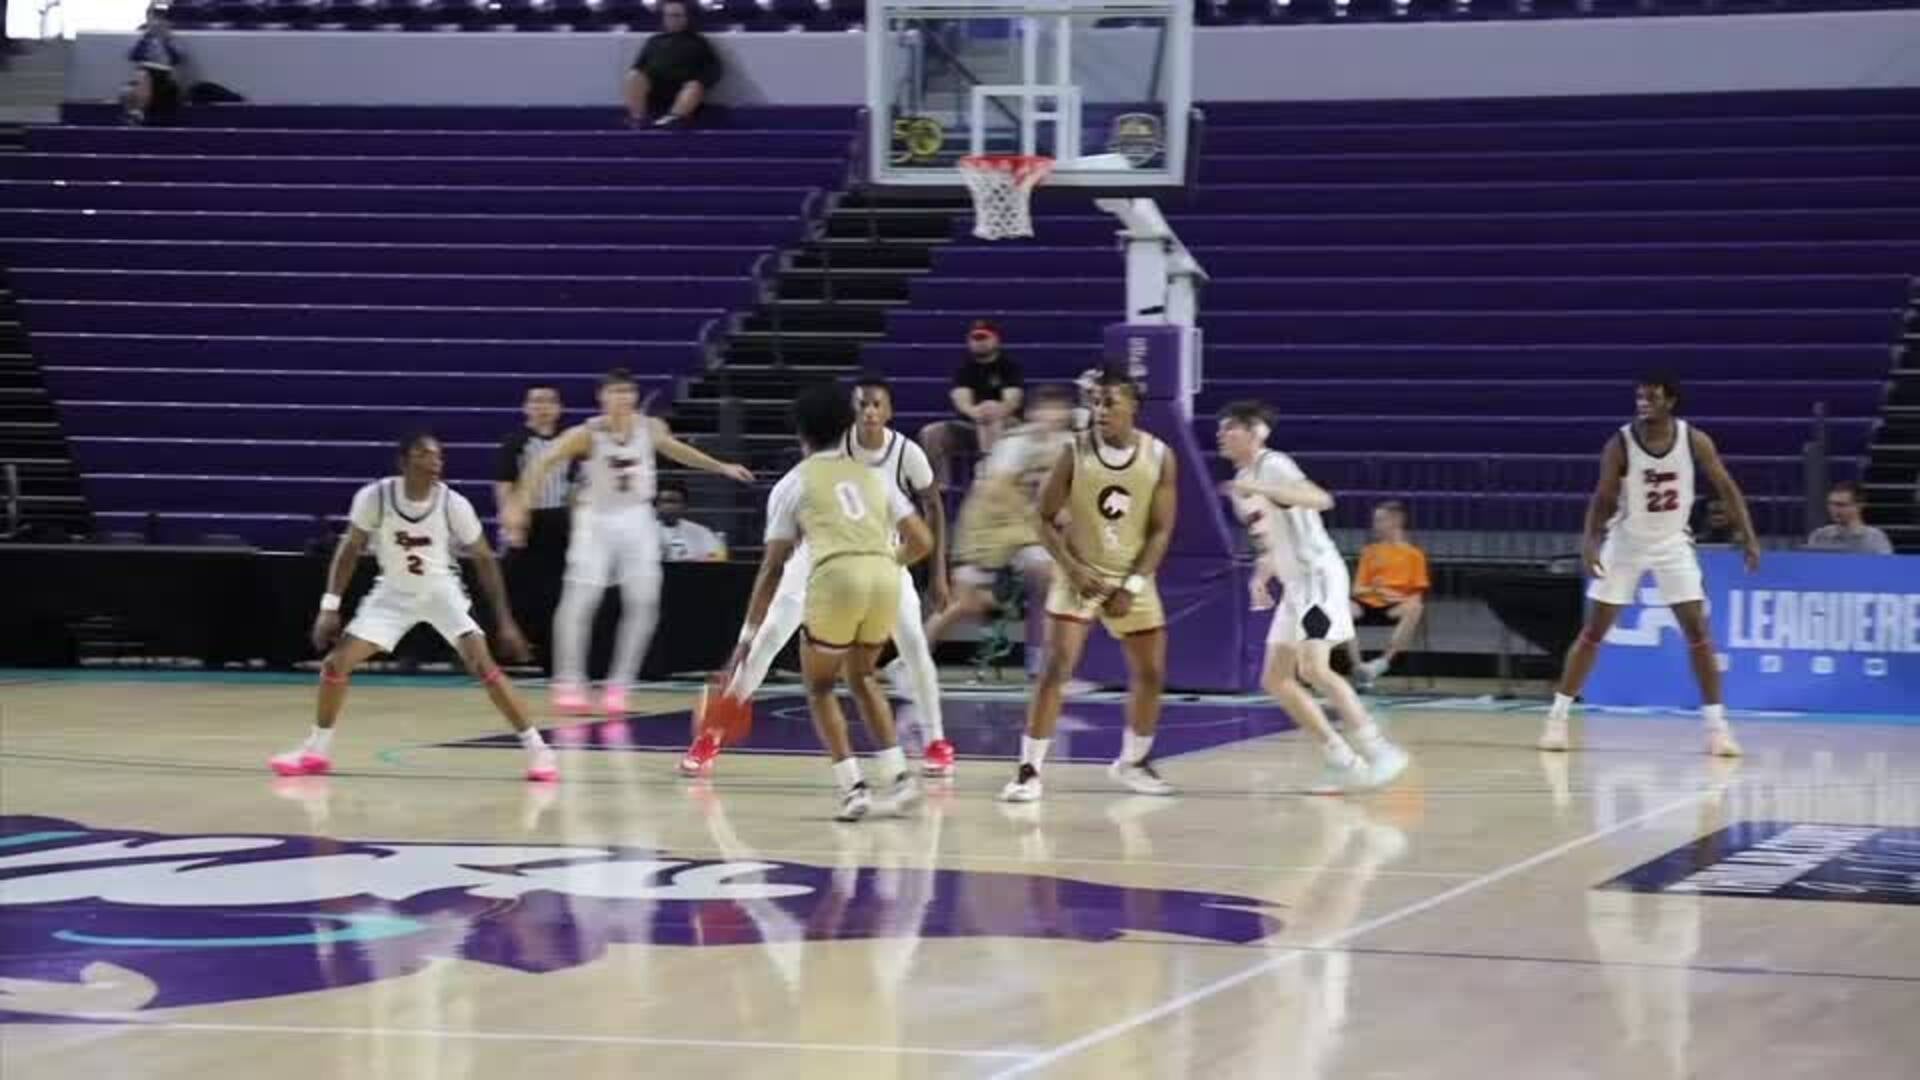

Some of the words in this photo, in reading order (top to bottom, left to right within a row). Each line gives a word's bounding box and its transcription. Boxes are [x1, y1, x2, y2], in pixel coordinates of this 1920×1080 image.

[835, 481, 865, 521] 0
[1647, 489, 1679, 513] 22
[406, 554, 424, 576] 2
